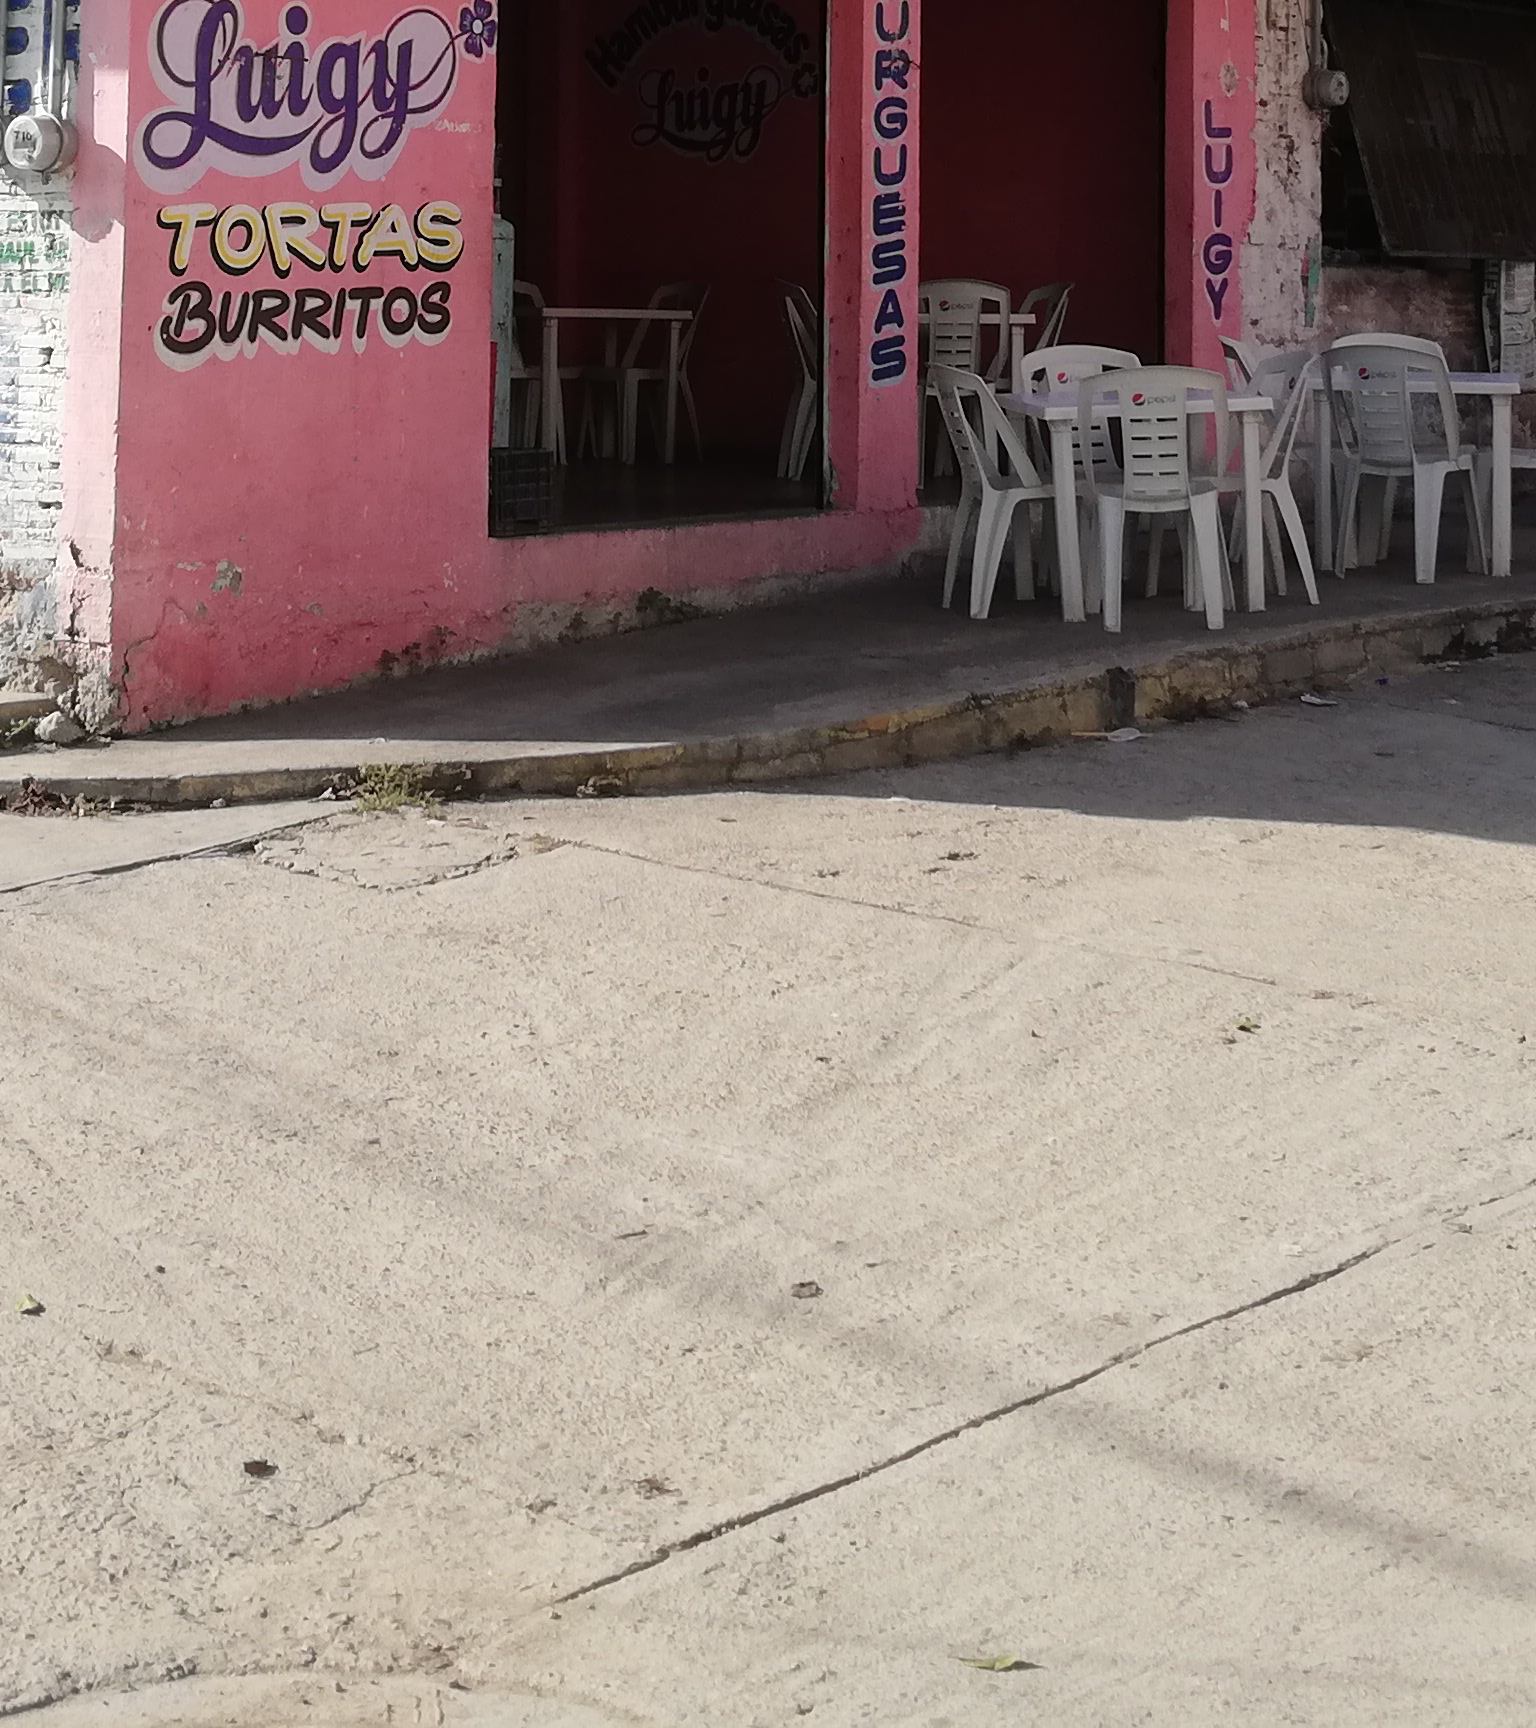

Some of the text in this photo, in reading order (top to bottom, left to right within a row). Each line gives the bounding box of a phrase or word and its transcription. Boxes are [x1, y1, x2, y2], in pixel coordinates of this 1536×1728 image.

[631, 64, 782, 163] Luigy
[156, 200, 465, 278] TORTAS
[1202, 98, 1233, 321] LUIGY
[160, 280, 453, 355] BURRITOS
